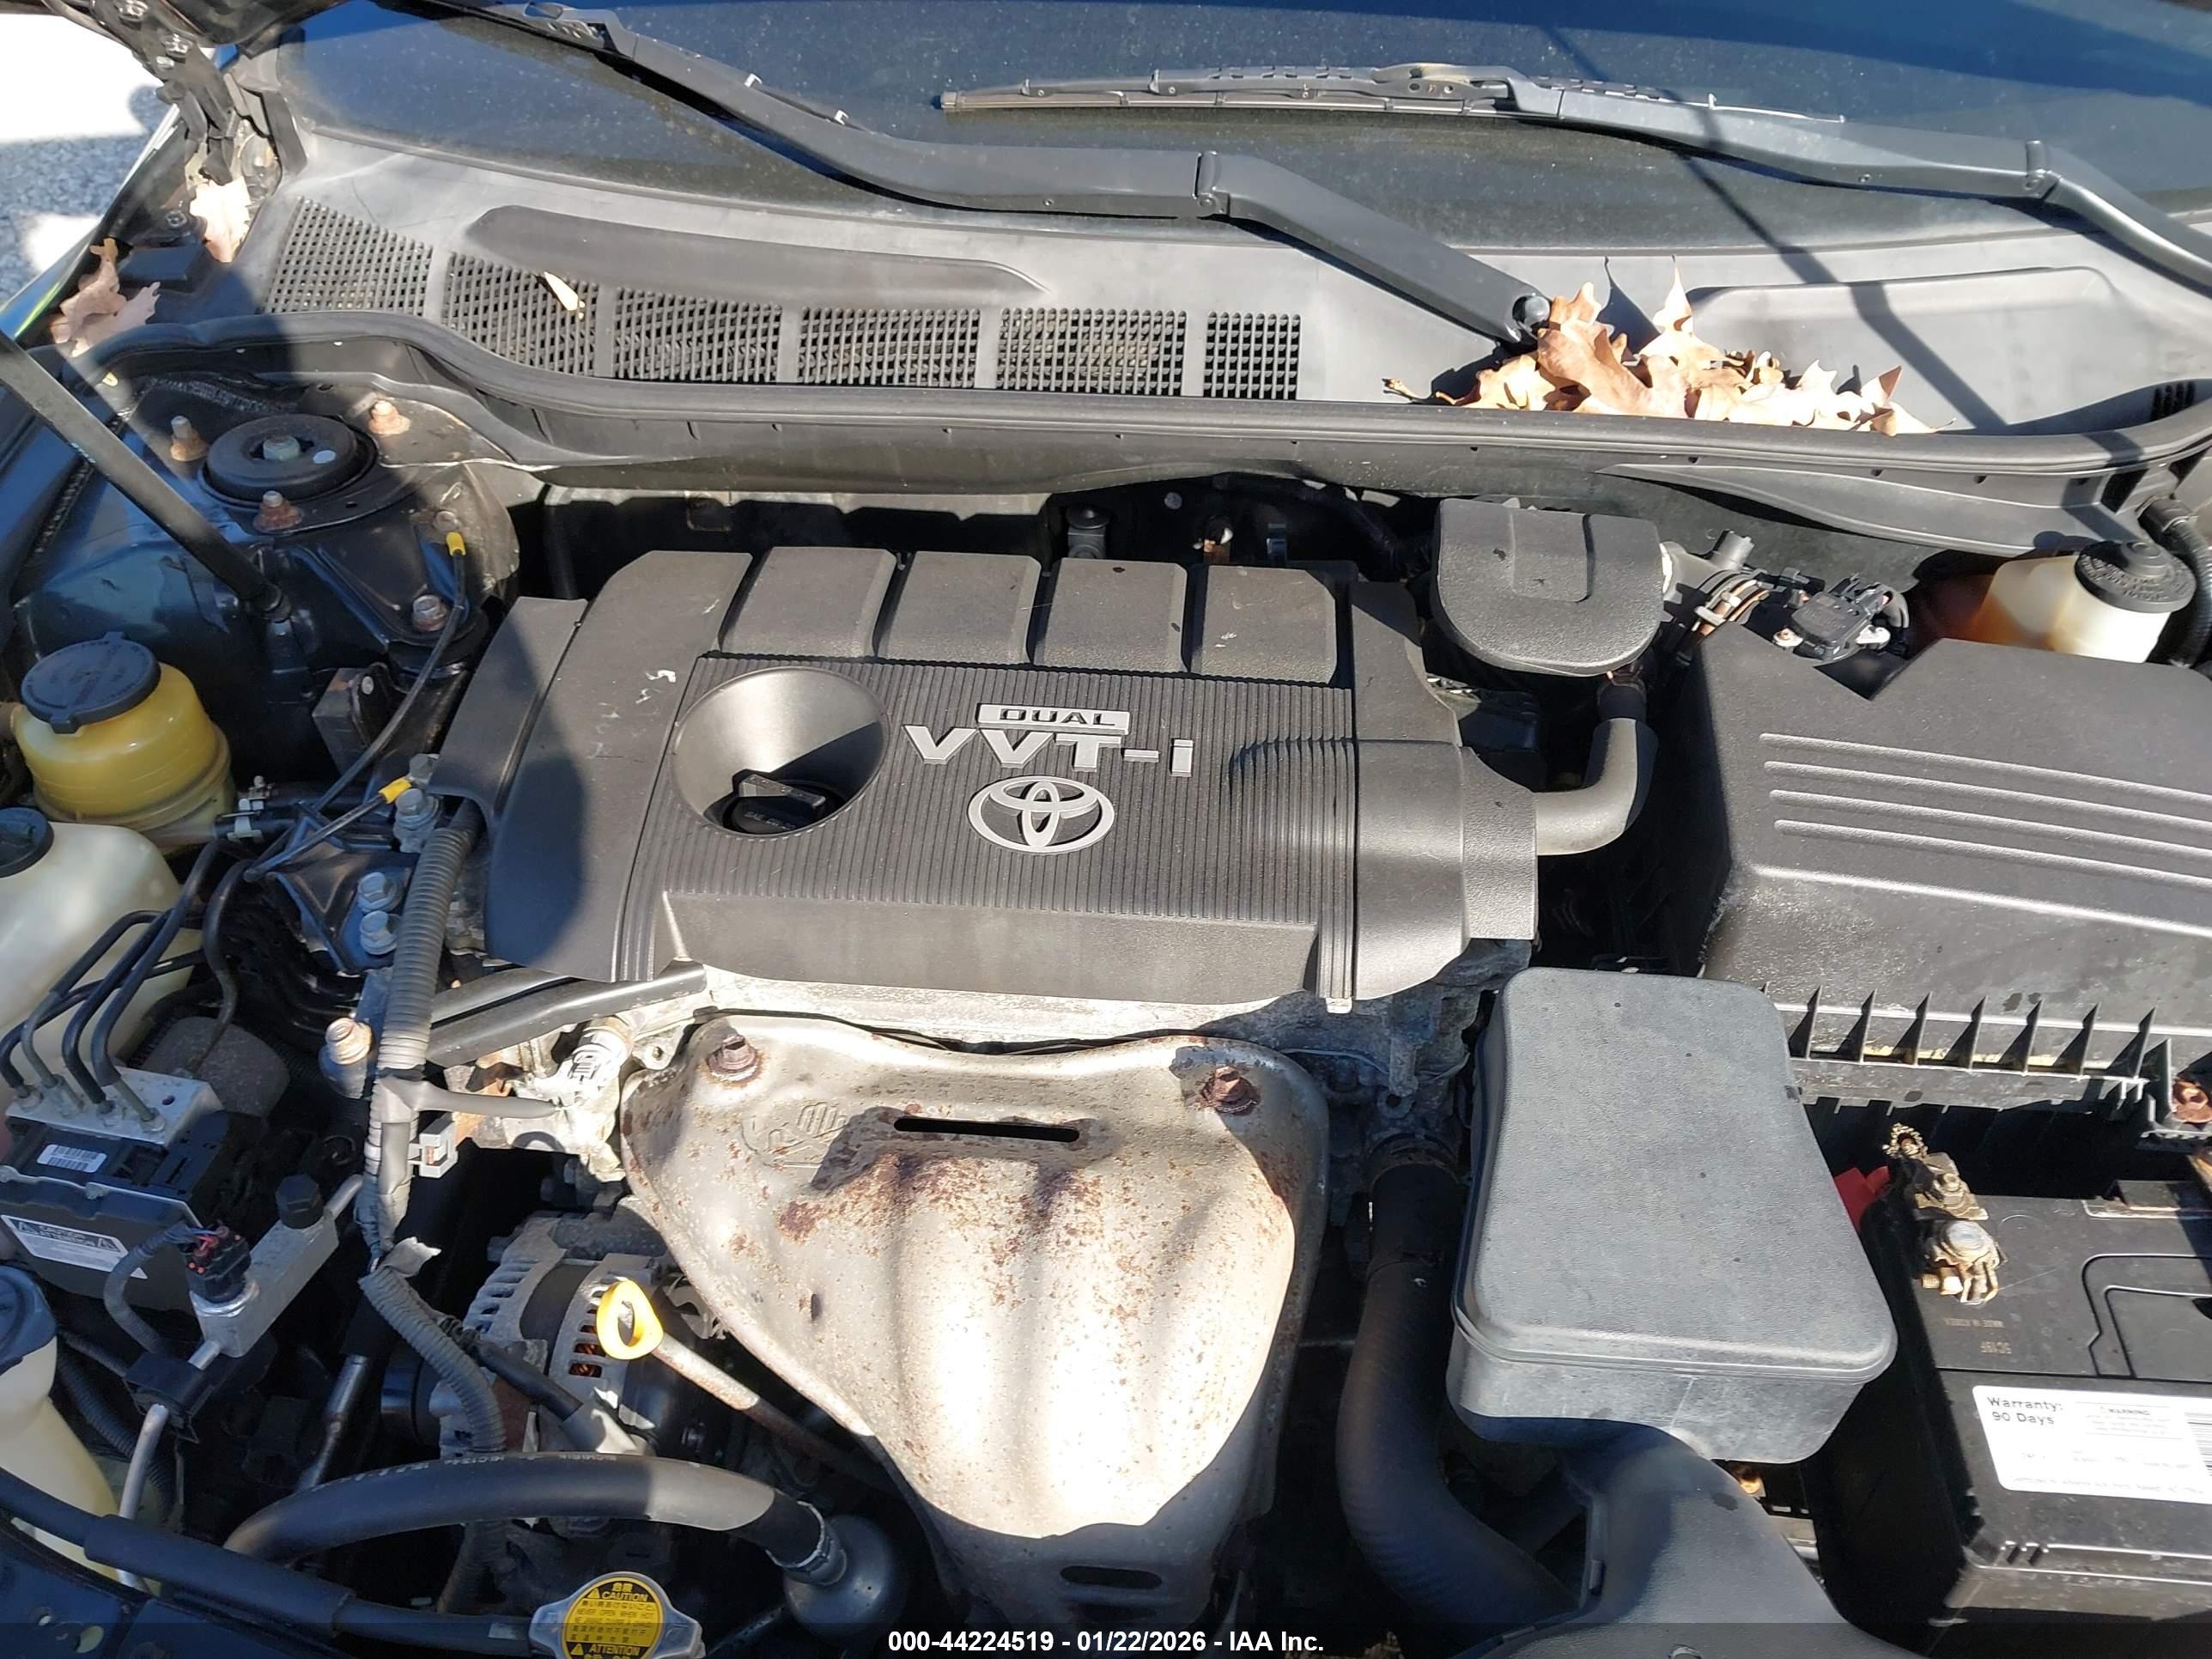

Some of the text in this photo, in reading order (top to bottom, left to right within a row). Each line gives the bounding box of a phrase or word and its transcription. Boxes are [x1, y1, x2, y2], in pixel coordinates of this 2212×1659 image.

[999, 707, 1117, 726] DUAL
[903, 725, 1194, 777] VVT-i
[1992, 1411, 2055, 1425] 90 Days
[602, 1591, 648, 1601] CAUTION
[589, 1644, 640, 1656] ATTENTION
